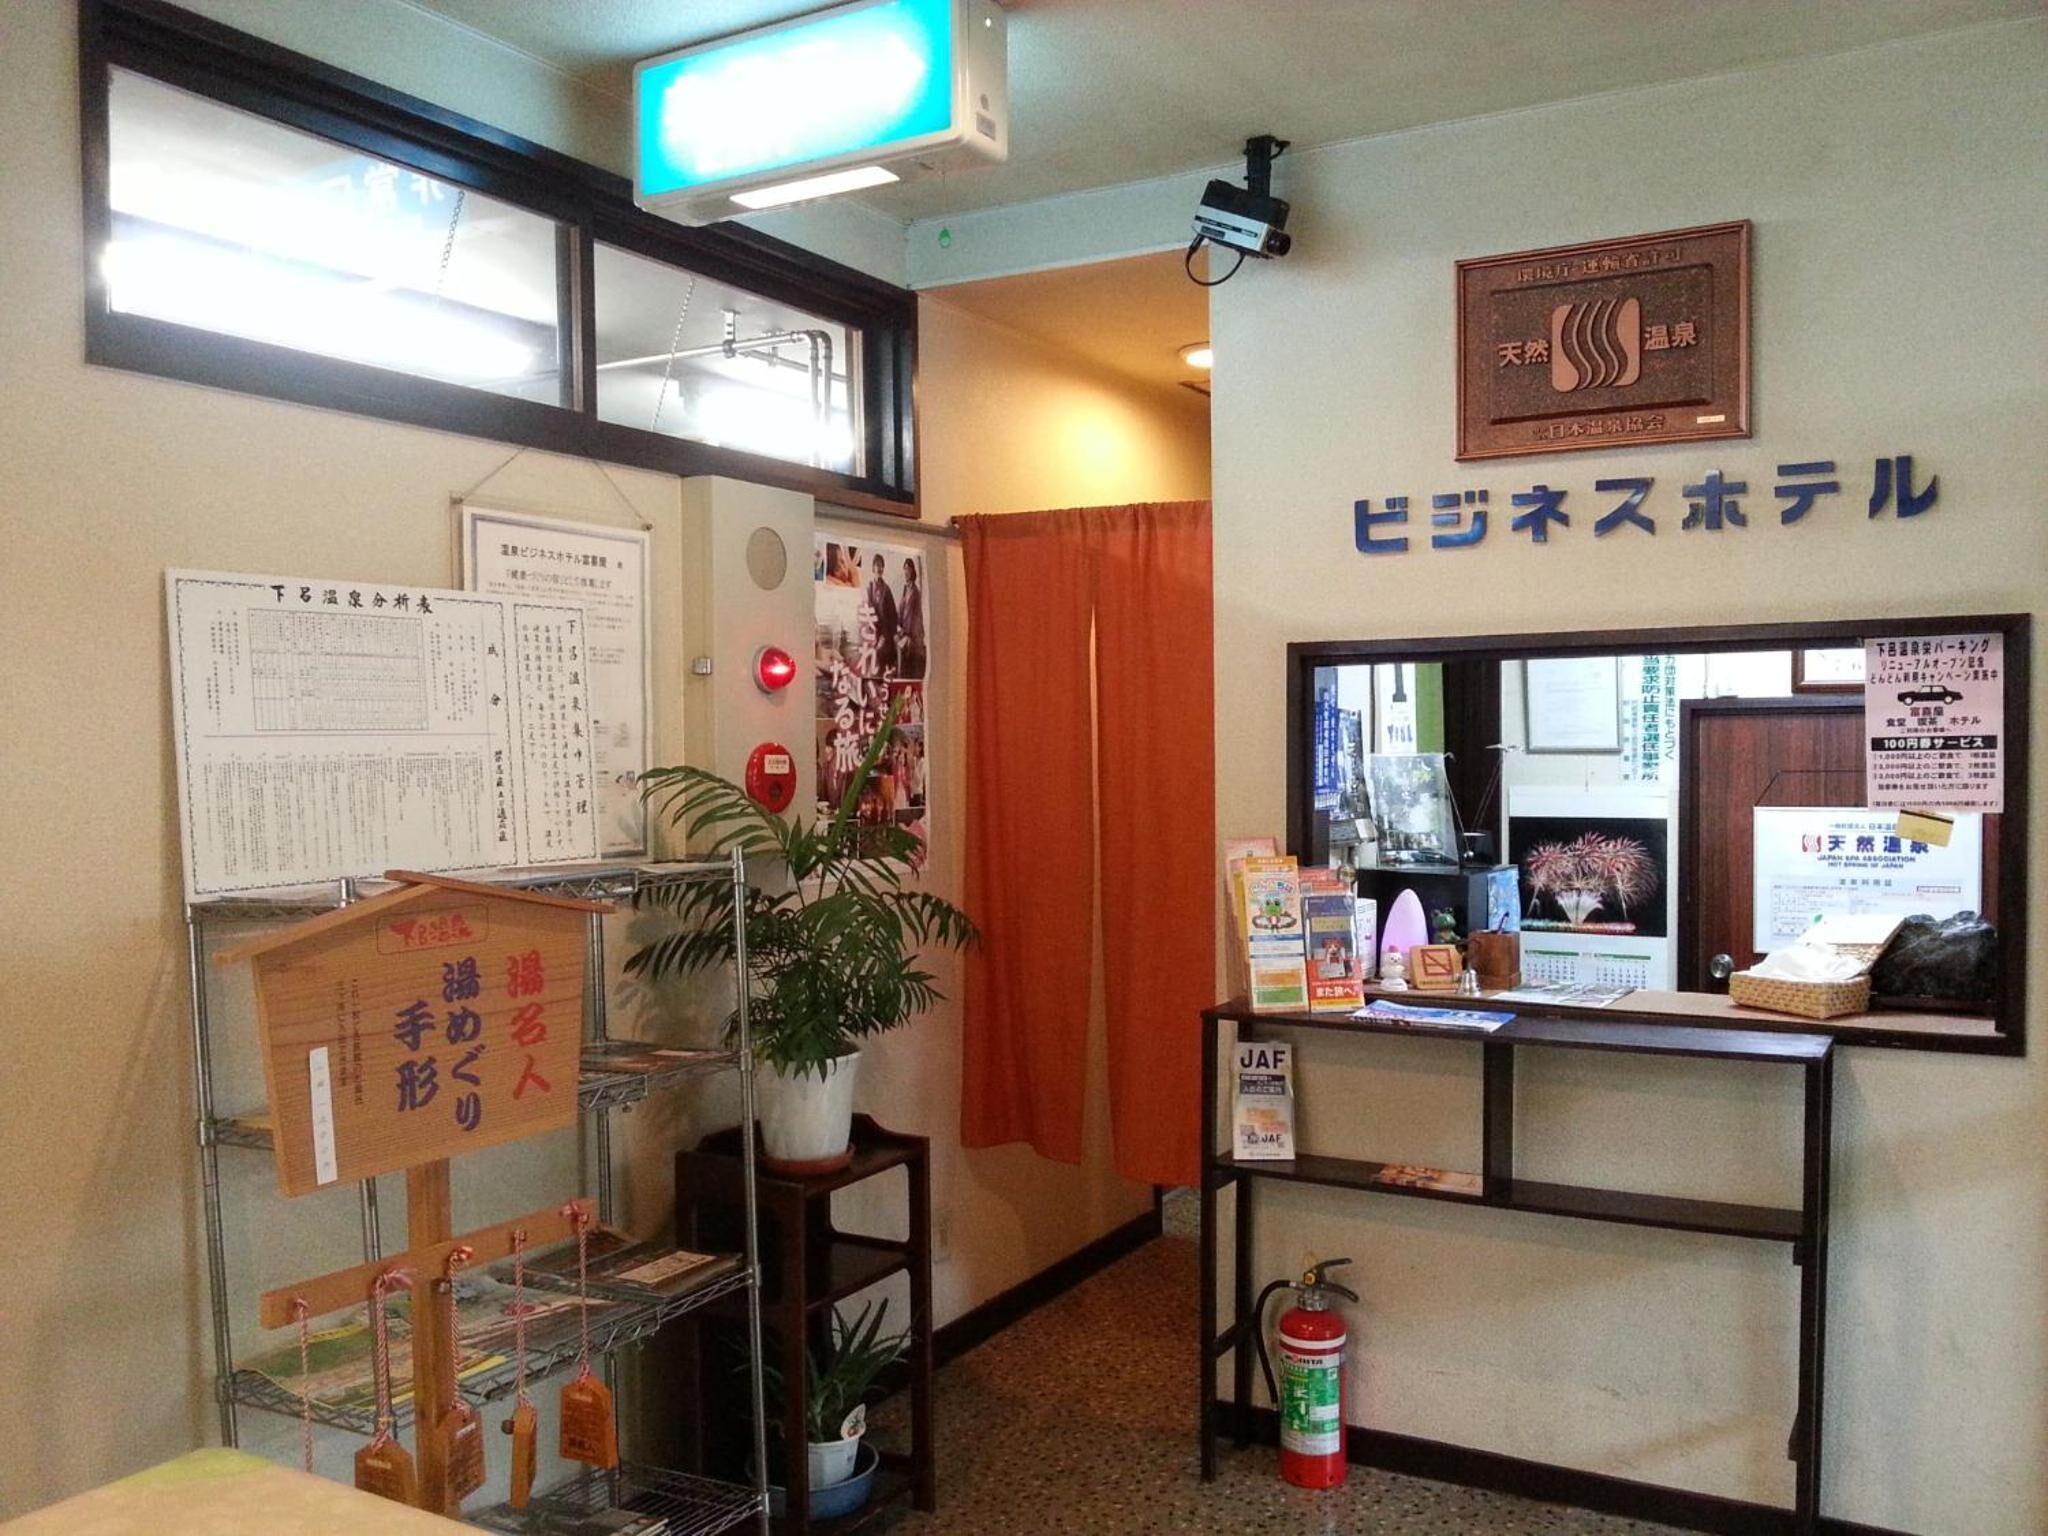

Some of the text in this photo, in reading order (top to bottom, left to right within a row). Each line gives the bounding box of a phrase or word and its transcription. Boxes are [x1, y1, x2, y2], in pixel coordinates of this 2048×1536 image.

[1499, 321, 1697, 368] 天然 温泉
[1353, 454, 1938, 554] ビジネスホテル
[270, 584, 433, 614] 下呂温泉分析表
[1950, 716, 1981, 726] ホテル
[1884, 737, 1984, 749] 100円券サービス
[442, 956, 486, 1131] 湯めぐり
[507, 950, 550, 1100] 湯名人
[394, 1000, 440, 1112] 手形
[1240, 1049, 1285, 1069] JAF
[1261, 1134, 1282, 1143] JAF
